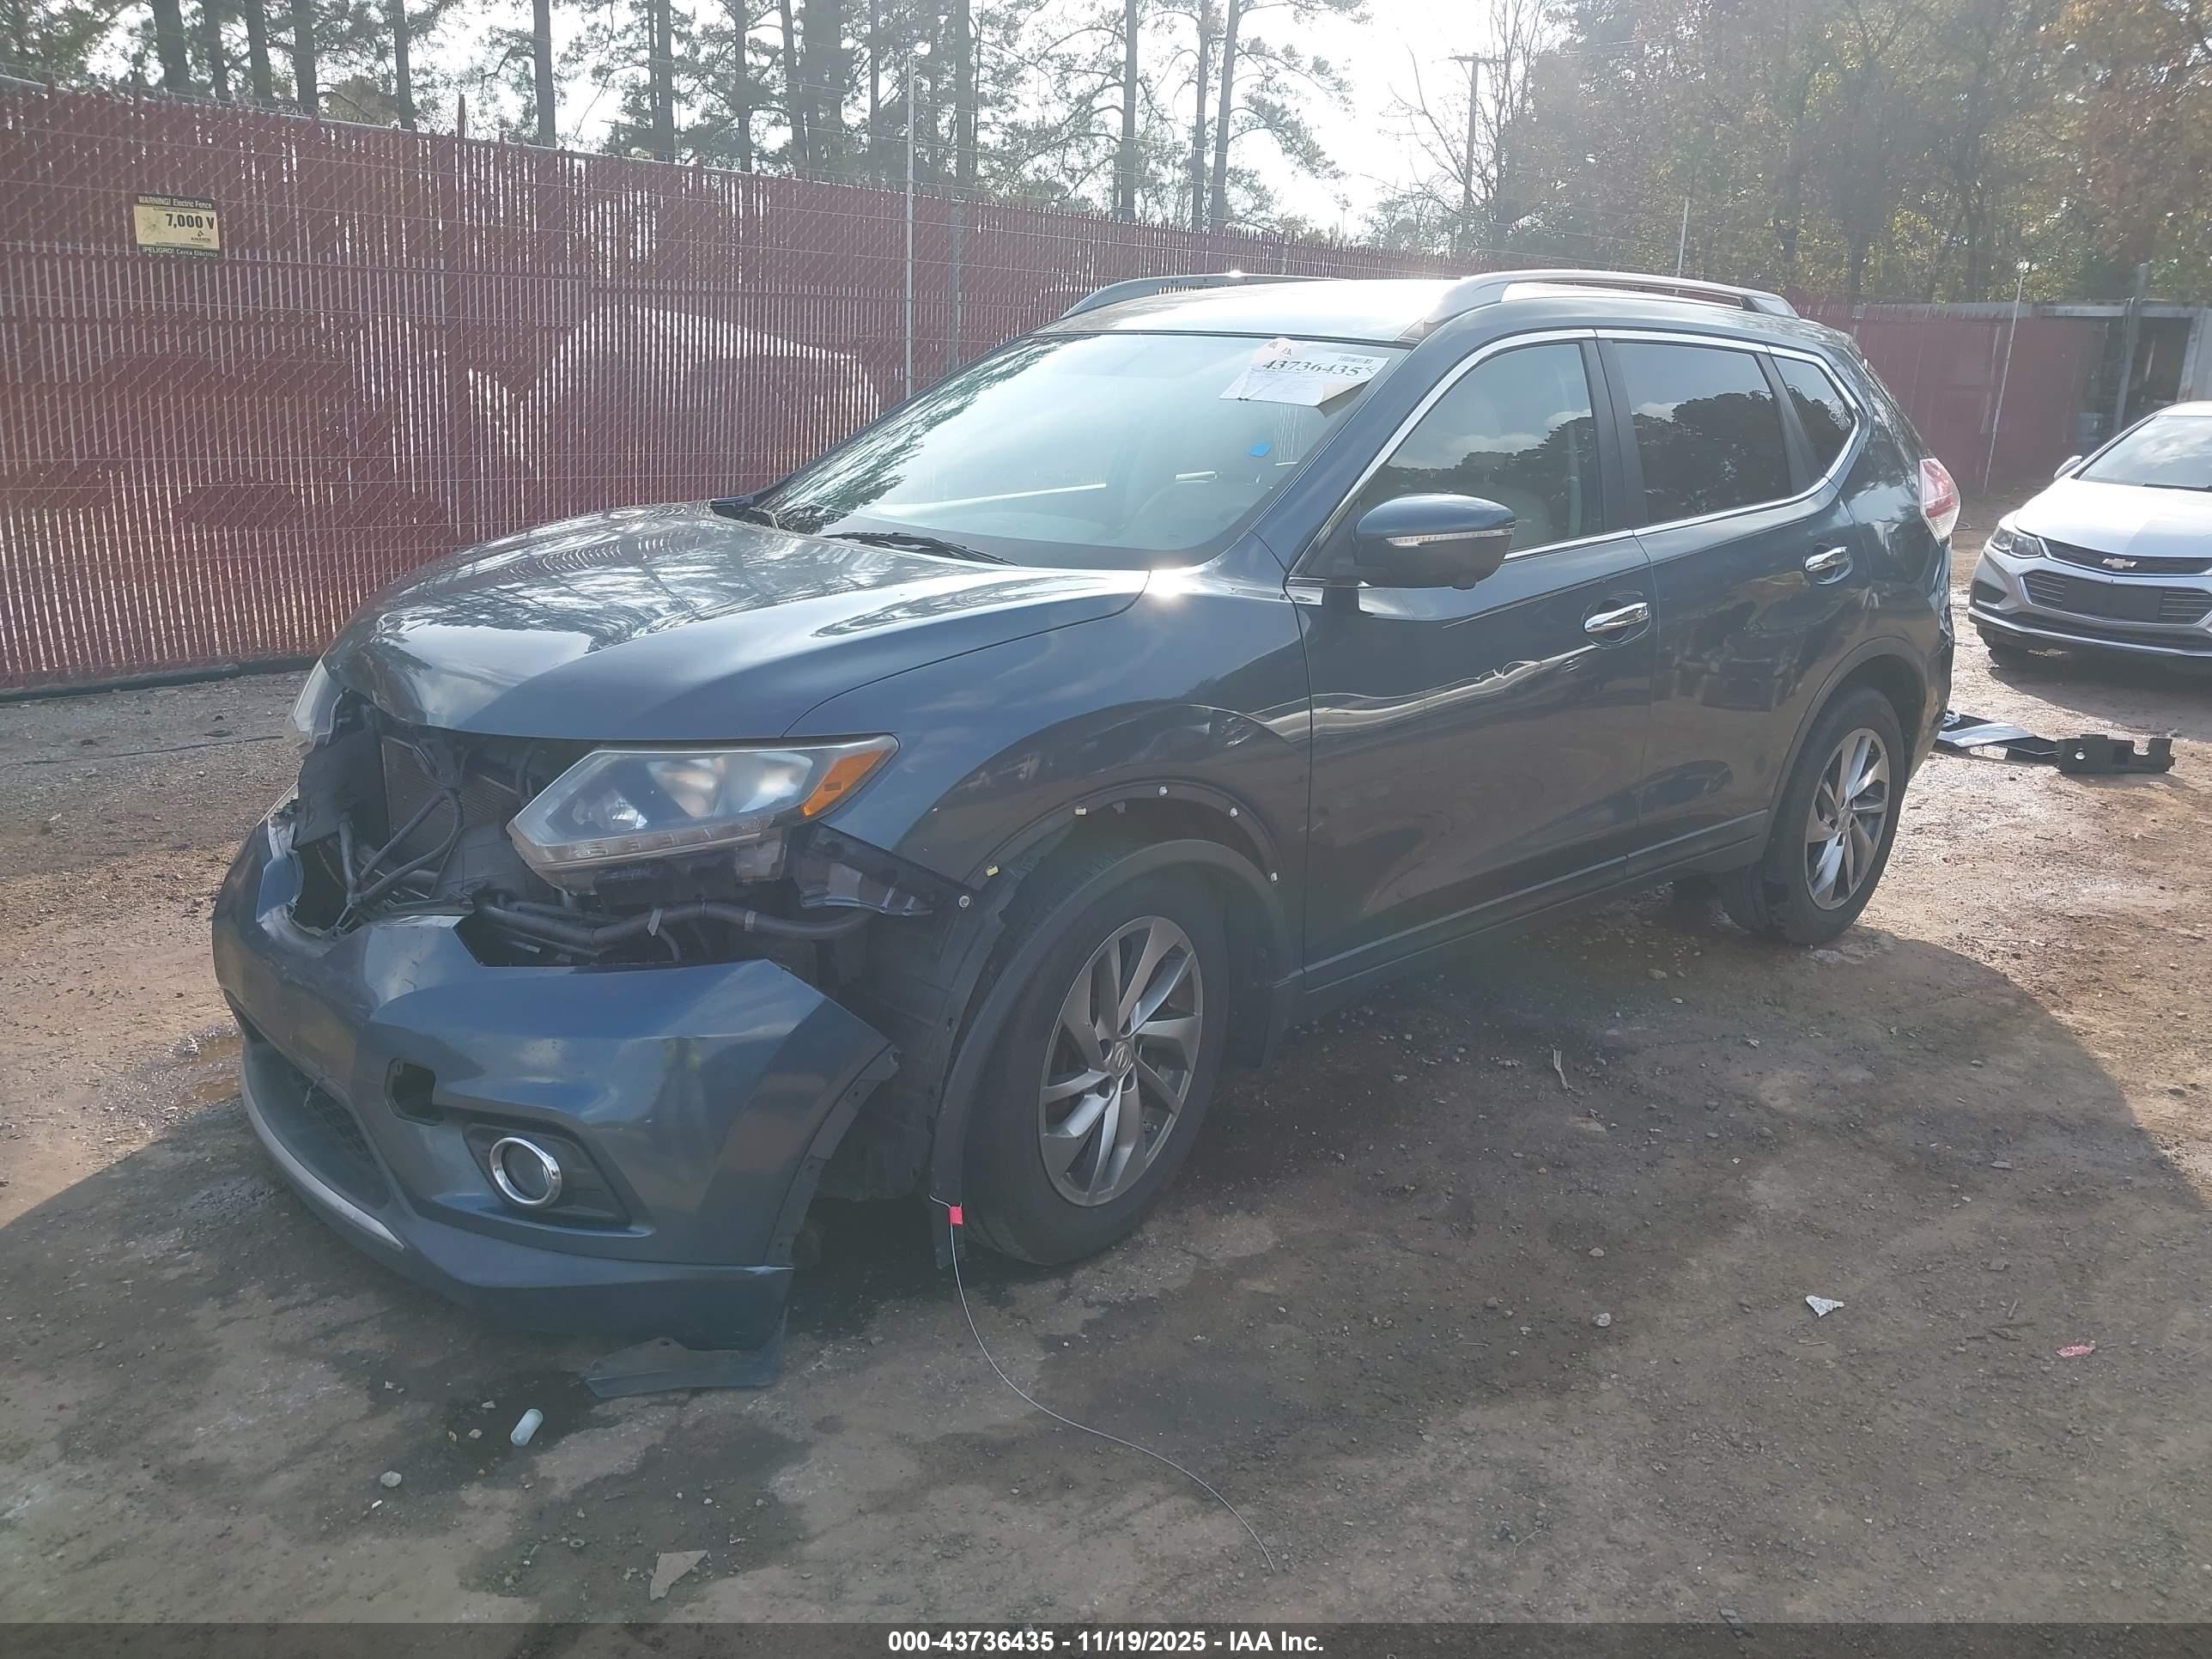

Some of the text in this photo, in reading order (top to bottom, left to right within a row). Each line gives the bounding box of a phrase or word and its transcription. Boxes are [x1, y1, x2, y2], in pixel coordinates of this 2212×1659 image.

[138, 196, 213, 210] WARNING! Electric Fence
[166, 213, 215, 229] 7,000 V
[1262, 359, 1363, 376] 43736435
